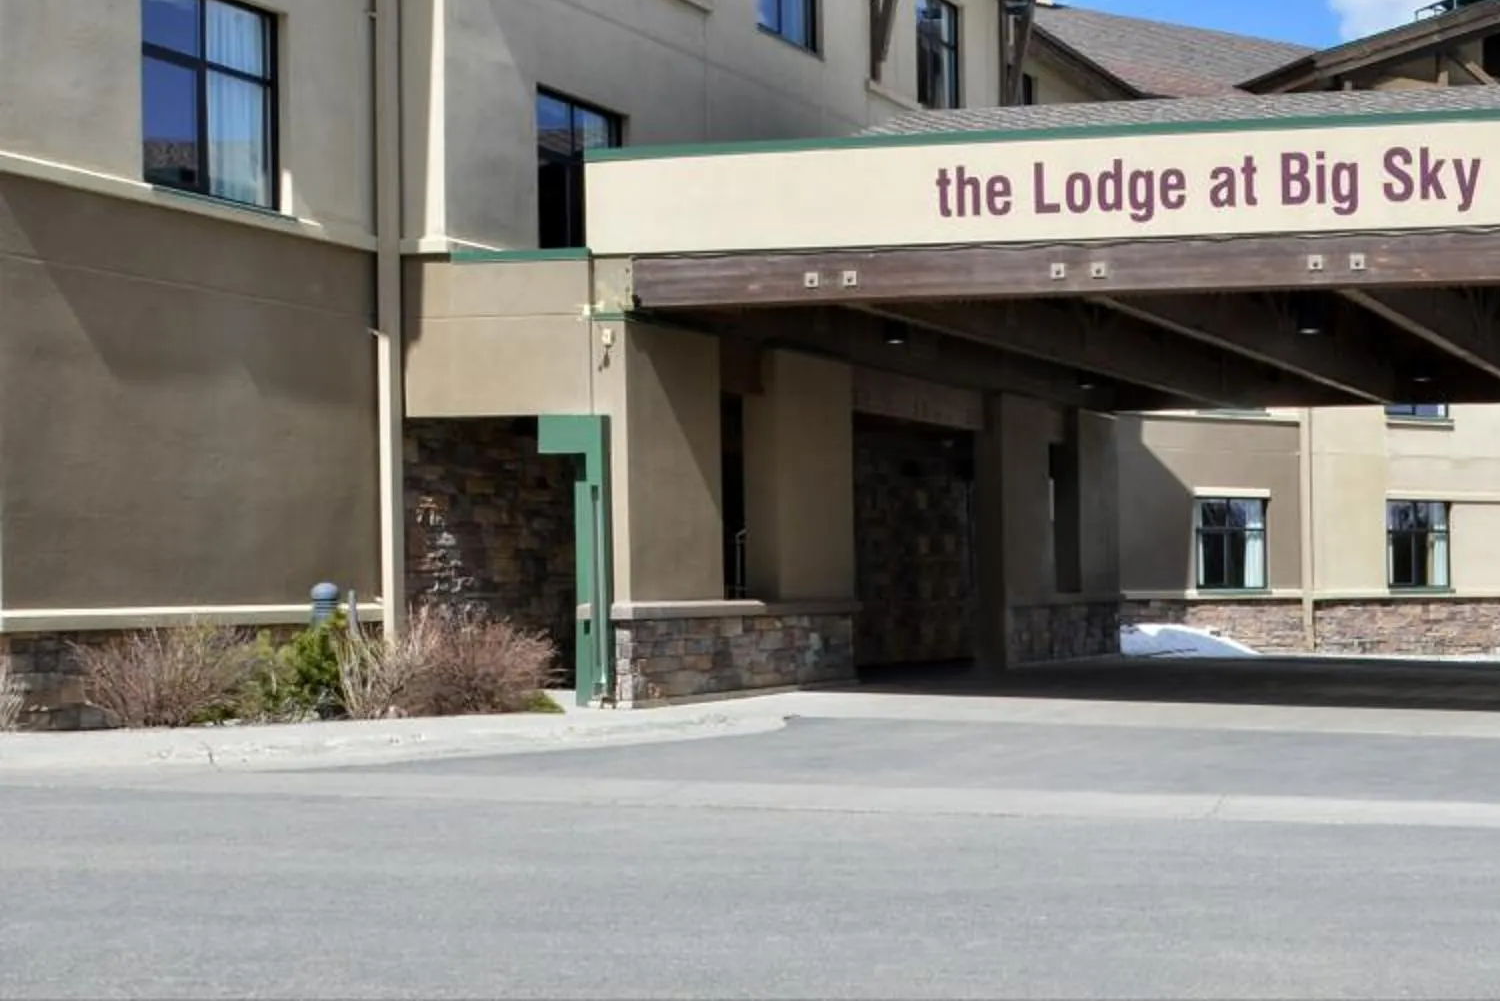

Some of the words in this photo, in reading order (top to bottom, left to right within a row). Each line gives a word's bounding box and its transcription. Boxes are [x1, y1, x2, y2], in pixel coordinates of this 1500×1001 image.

[936, 167, 1012, 218] the
[1033, 159, 1187, 223] Lodge
[1209, 155, 1258, 208] at
[1281, 151, 1359, 216] Big
[1383, 146, 1482, 212] Sky
